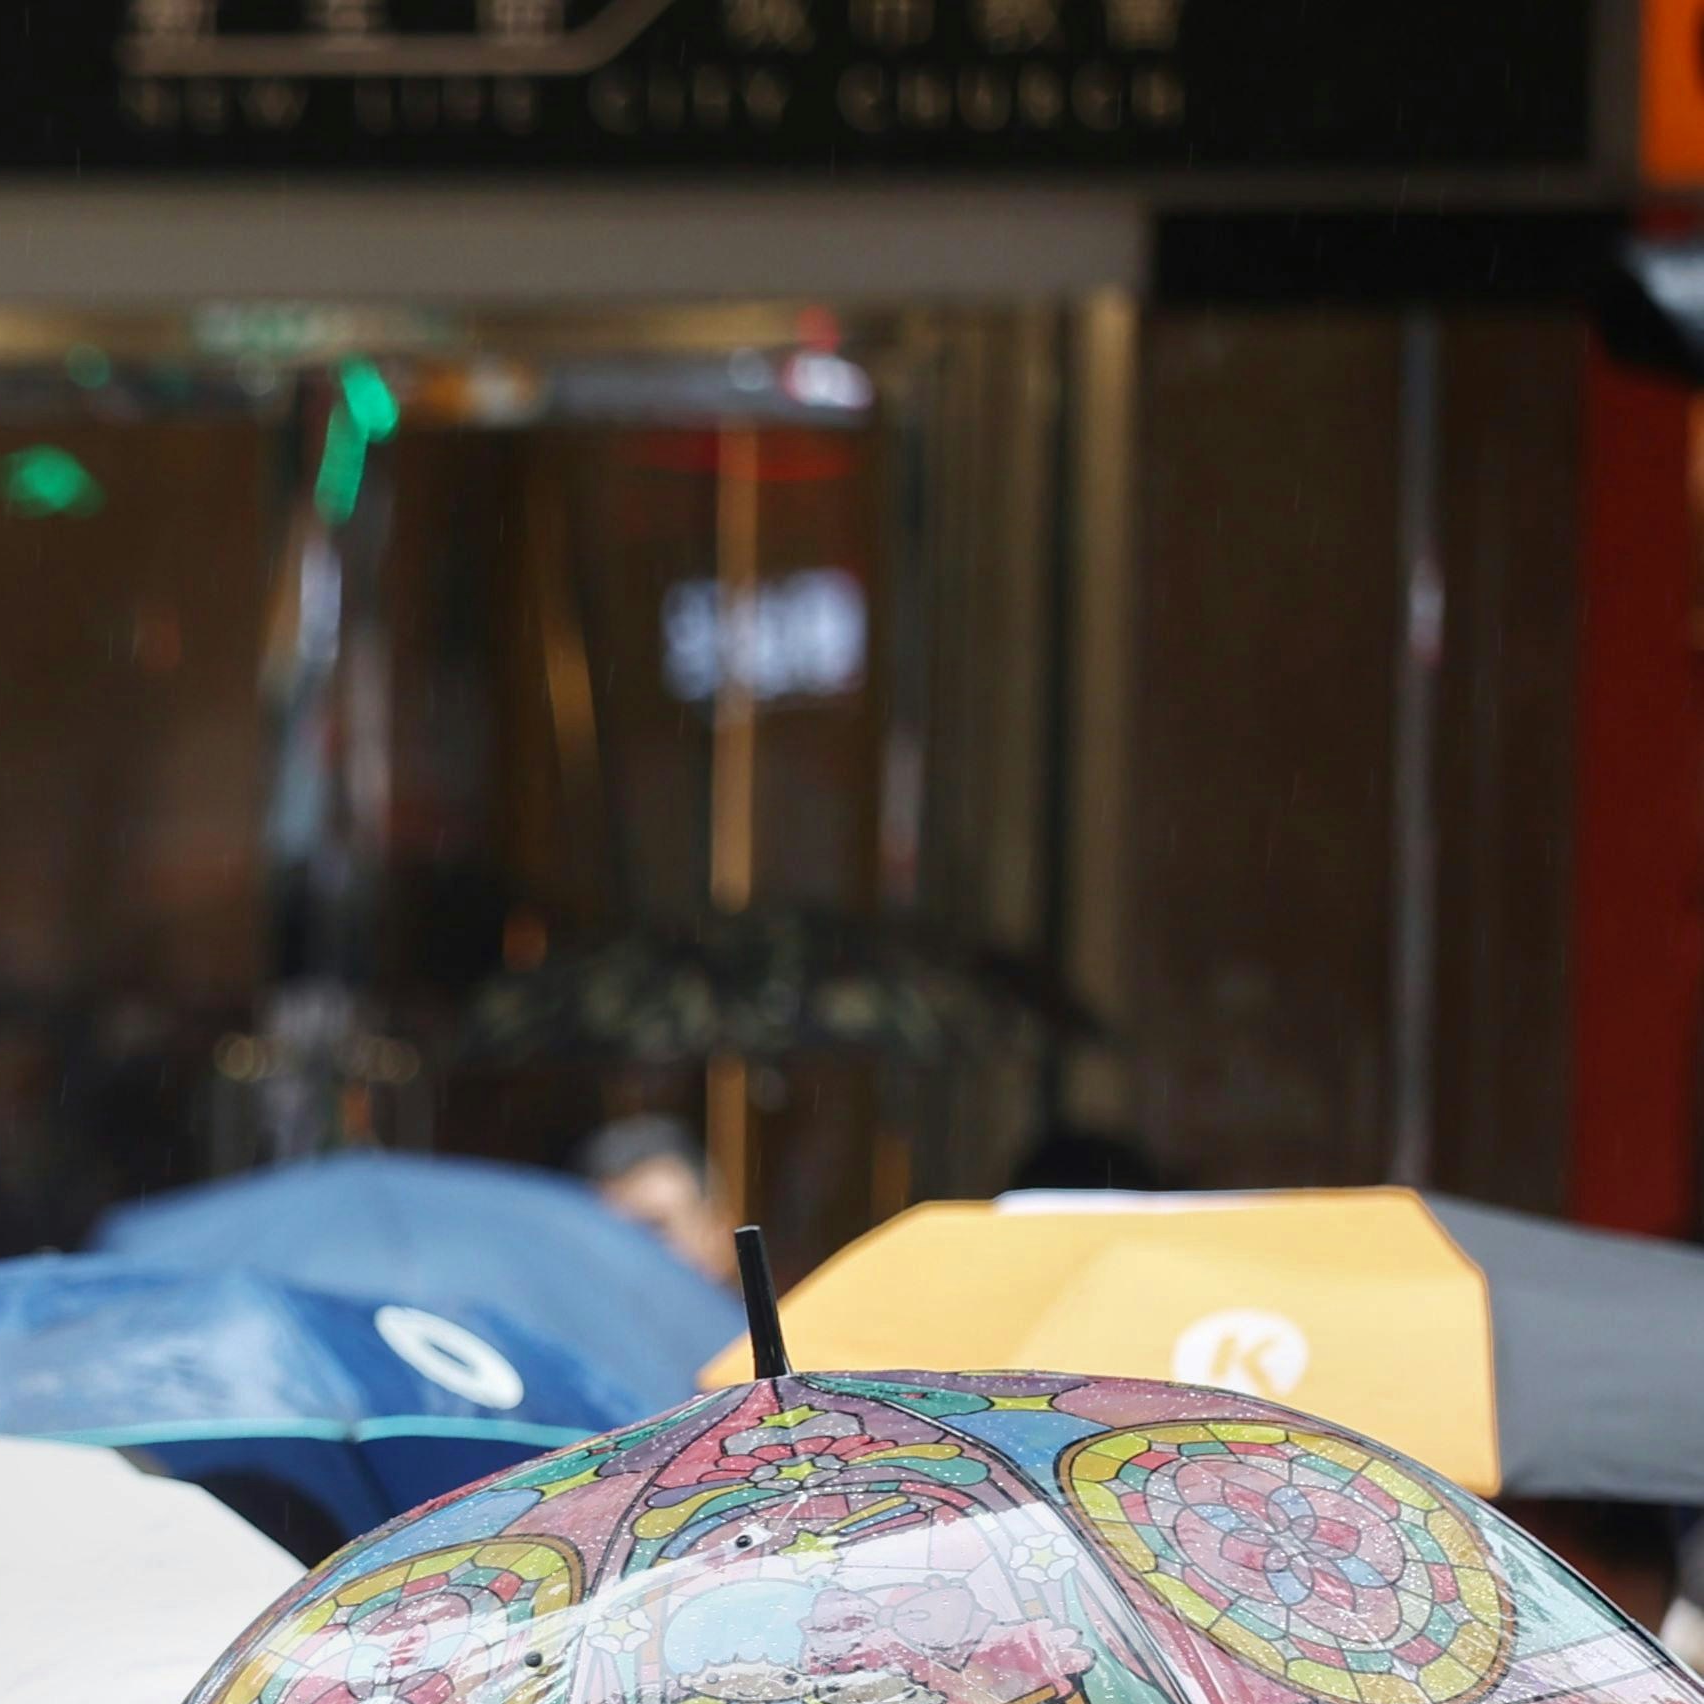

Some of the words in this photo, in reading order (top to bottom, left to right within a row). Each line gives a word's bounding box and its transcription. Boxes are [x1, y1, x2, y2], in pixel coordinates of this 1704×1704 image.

[123, 76, 303, 133] NEW
[357, 76, 538, 133] LIFE
[592, 70, 786, 132] CITY
[839, 66, 1183, 132] CHURCH
